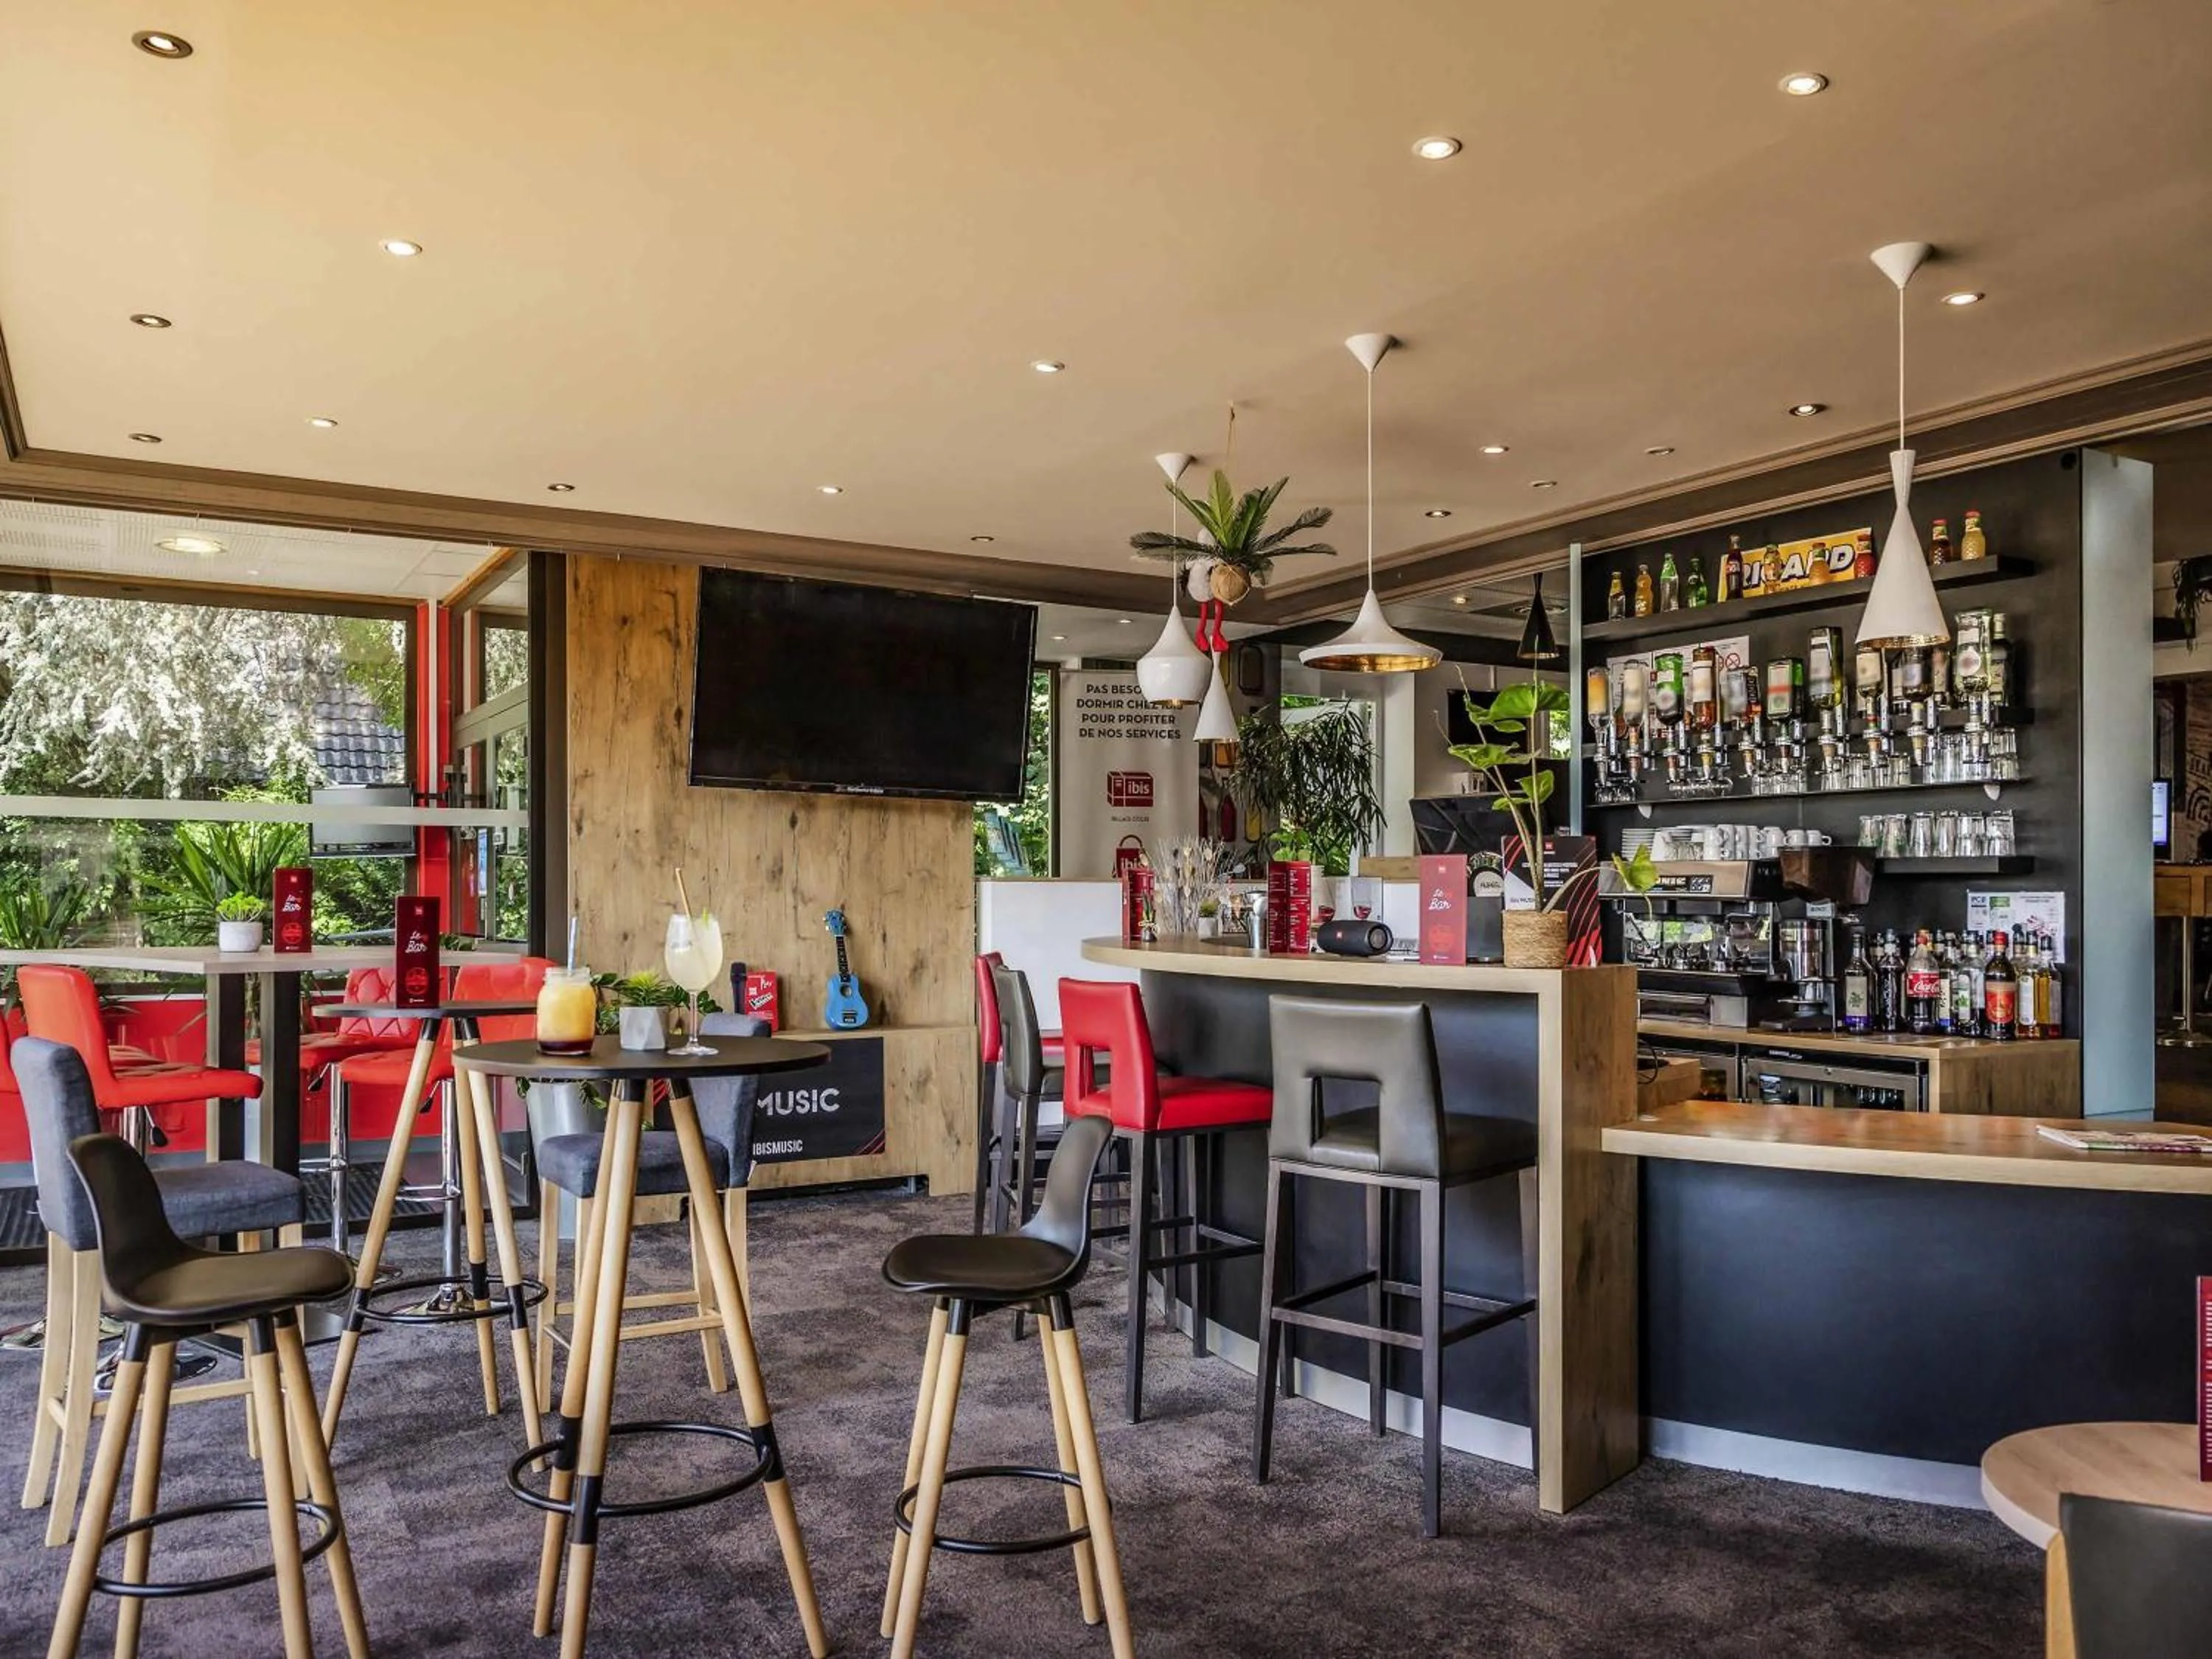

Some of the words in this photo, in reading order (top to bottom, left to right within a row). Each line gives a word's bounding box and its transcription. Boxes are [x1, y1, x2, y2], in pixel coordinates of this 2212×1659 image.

[1742, 543, 1856, 589] IAD
[1086, 684, 1108, 694] PAS
[1111, 684, 1142, 694] BESO
[1077, 698, 1125, 709] DORMIR
[1127, 700, 1158, 710] CHEZ
[1082, 713, 1116, 724] POUR
[1118, 714, 1176, 725] PROFITER
[1079, 728, 1095, 737] DE
[1098, 728, 1123, 738] NOS
[1125, 728, 1181, 740] SERVICES
[1127, 781, 1150, 794] ibis
[757, 1088, 841, 1116] MUSIC
[752, 1139, 804, 1156] IBISMUSIC
